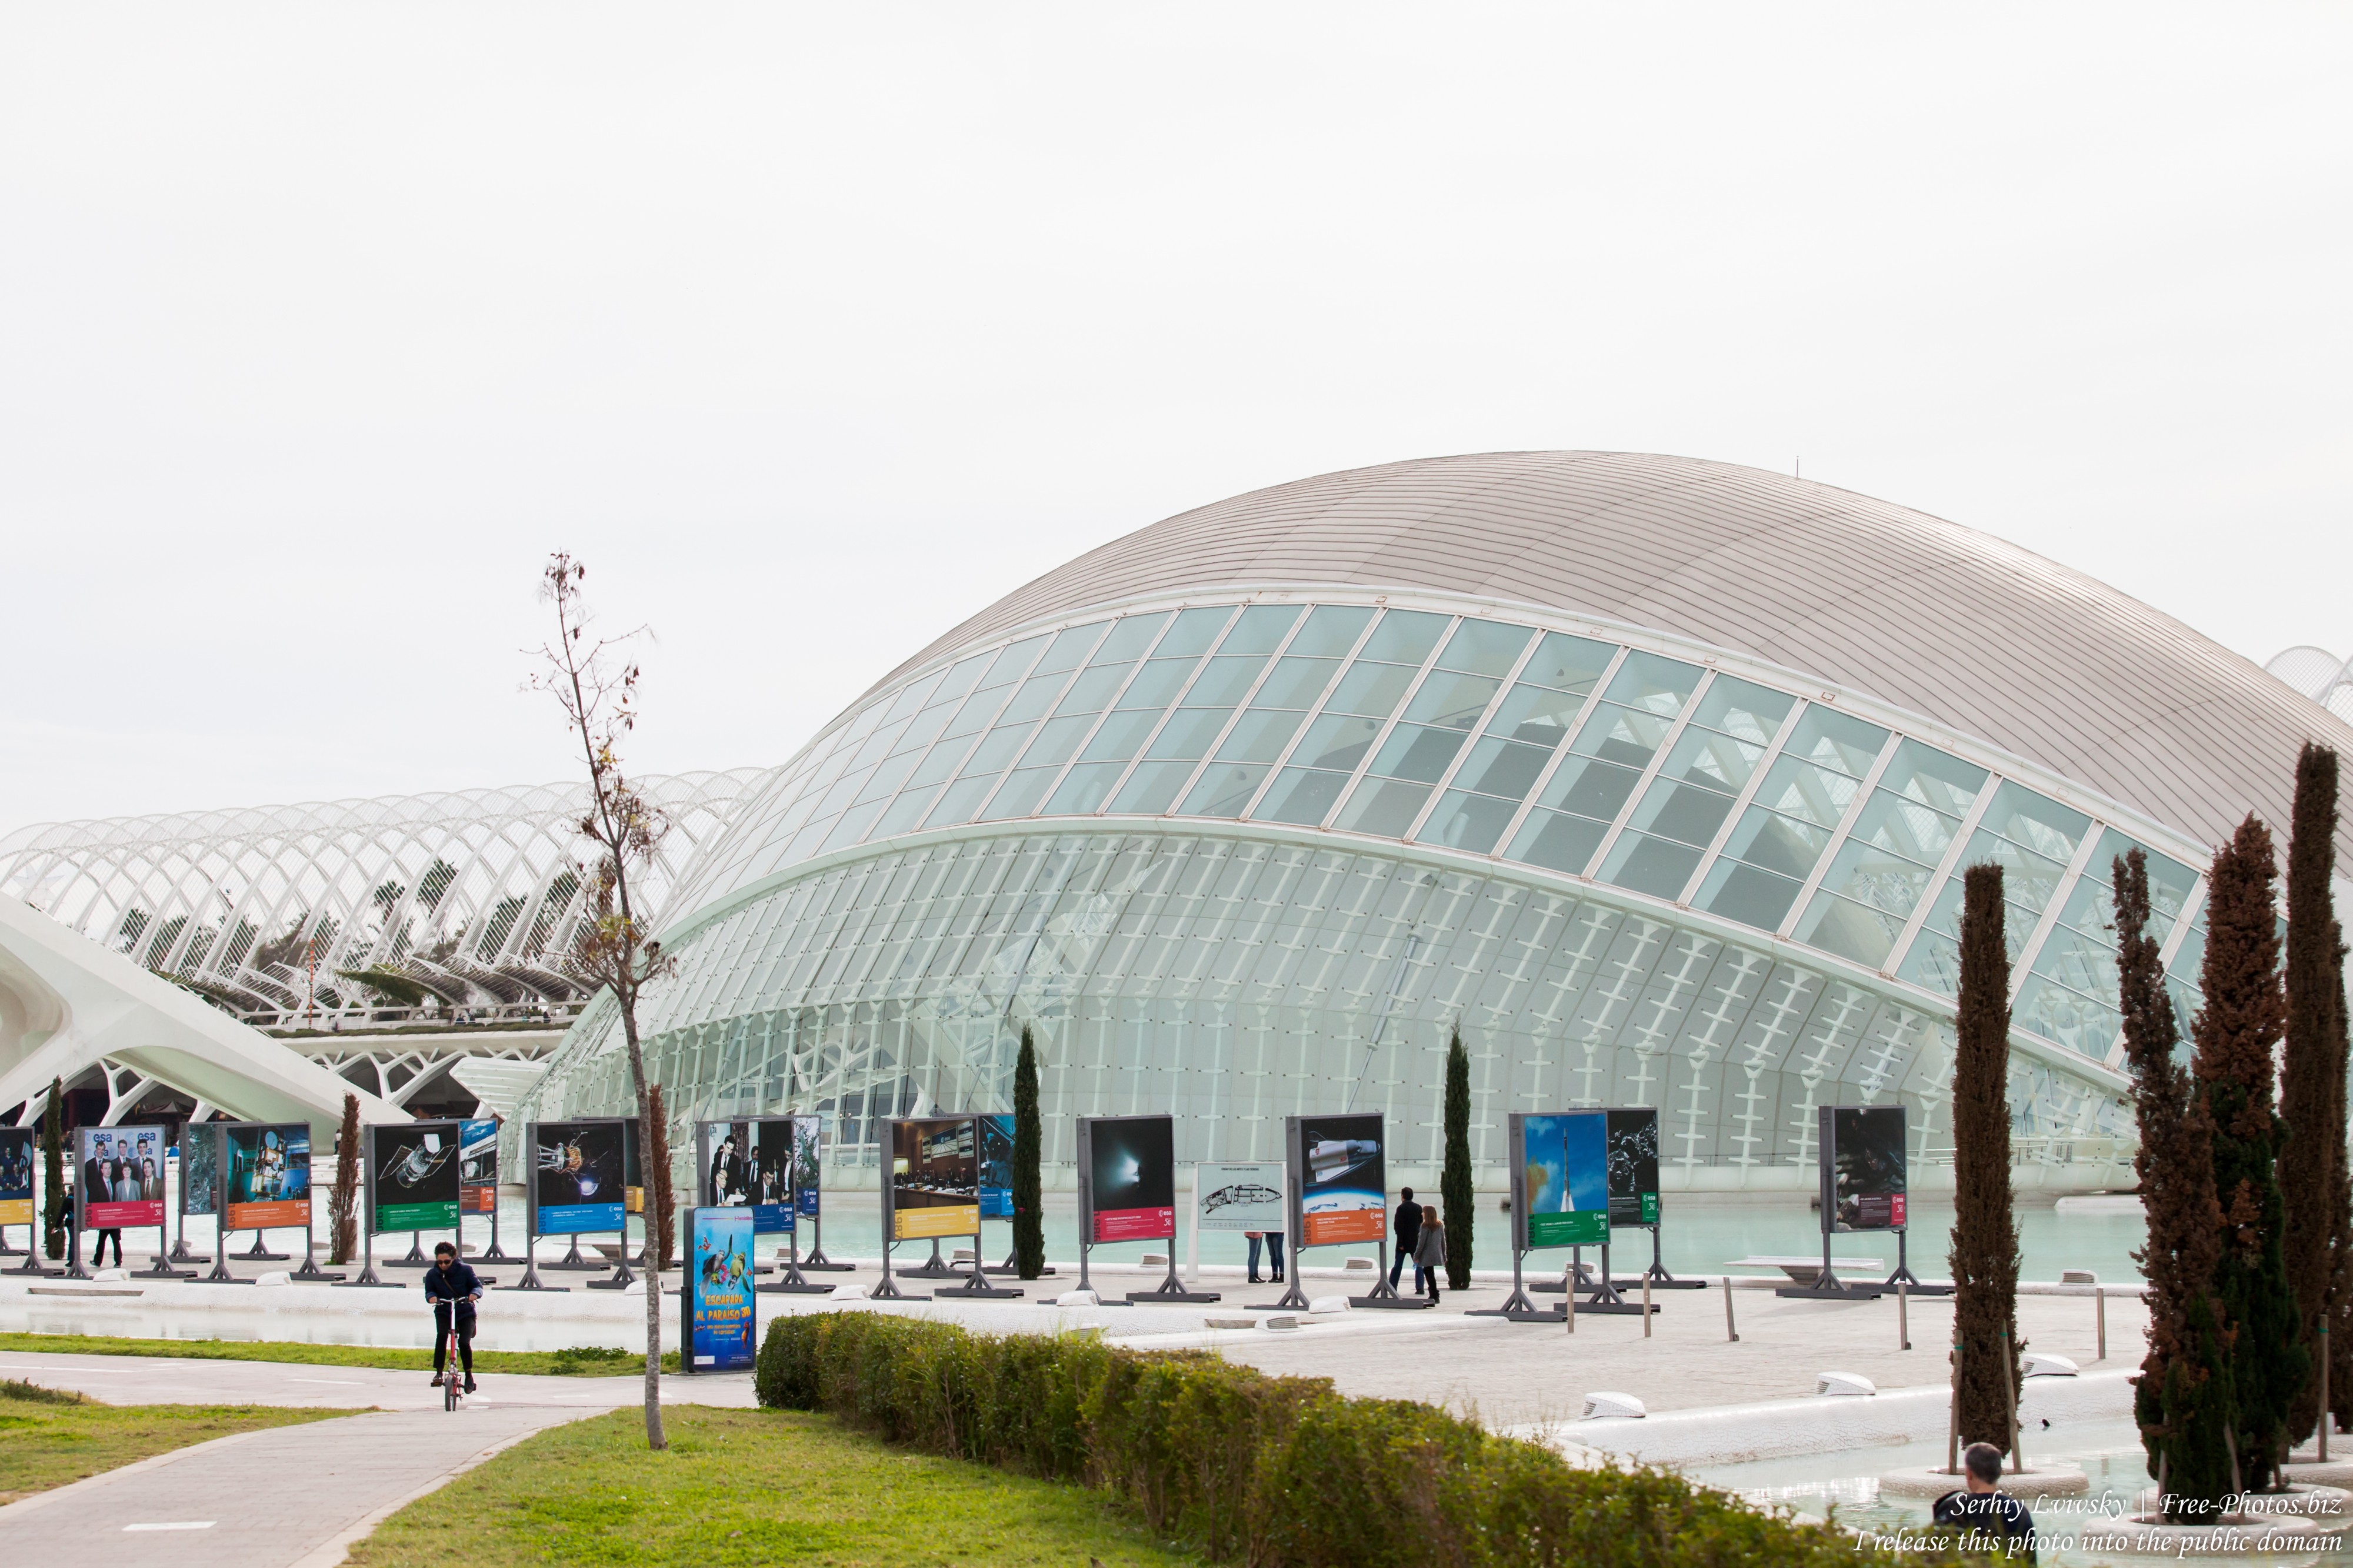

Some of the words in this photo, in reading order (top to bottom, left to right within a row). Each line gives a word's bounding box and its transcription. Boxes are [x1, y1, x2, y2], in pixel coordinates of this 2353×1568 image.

[94, 1133, 112, 1142] esa
[137, 1132, 156, 1141] esa
[538, 1206, 546, 1233] 1989
[895, 1209, 903, 1239] 1987
[1304, 1211, 1312, 1245] 1985
[695, 1310, 705, 1321] AL
[740, 1306, 751, 1319] 3D
